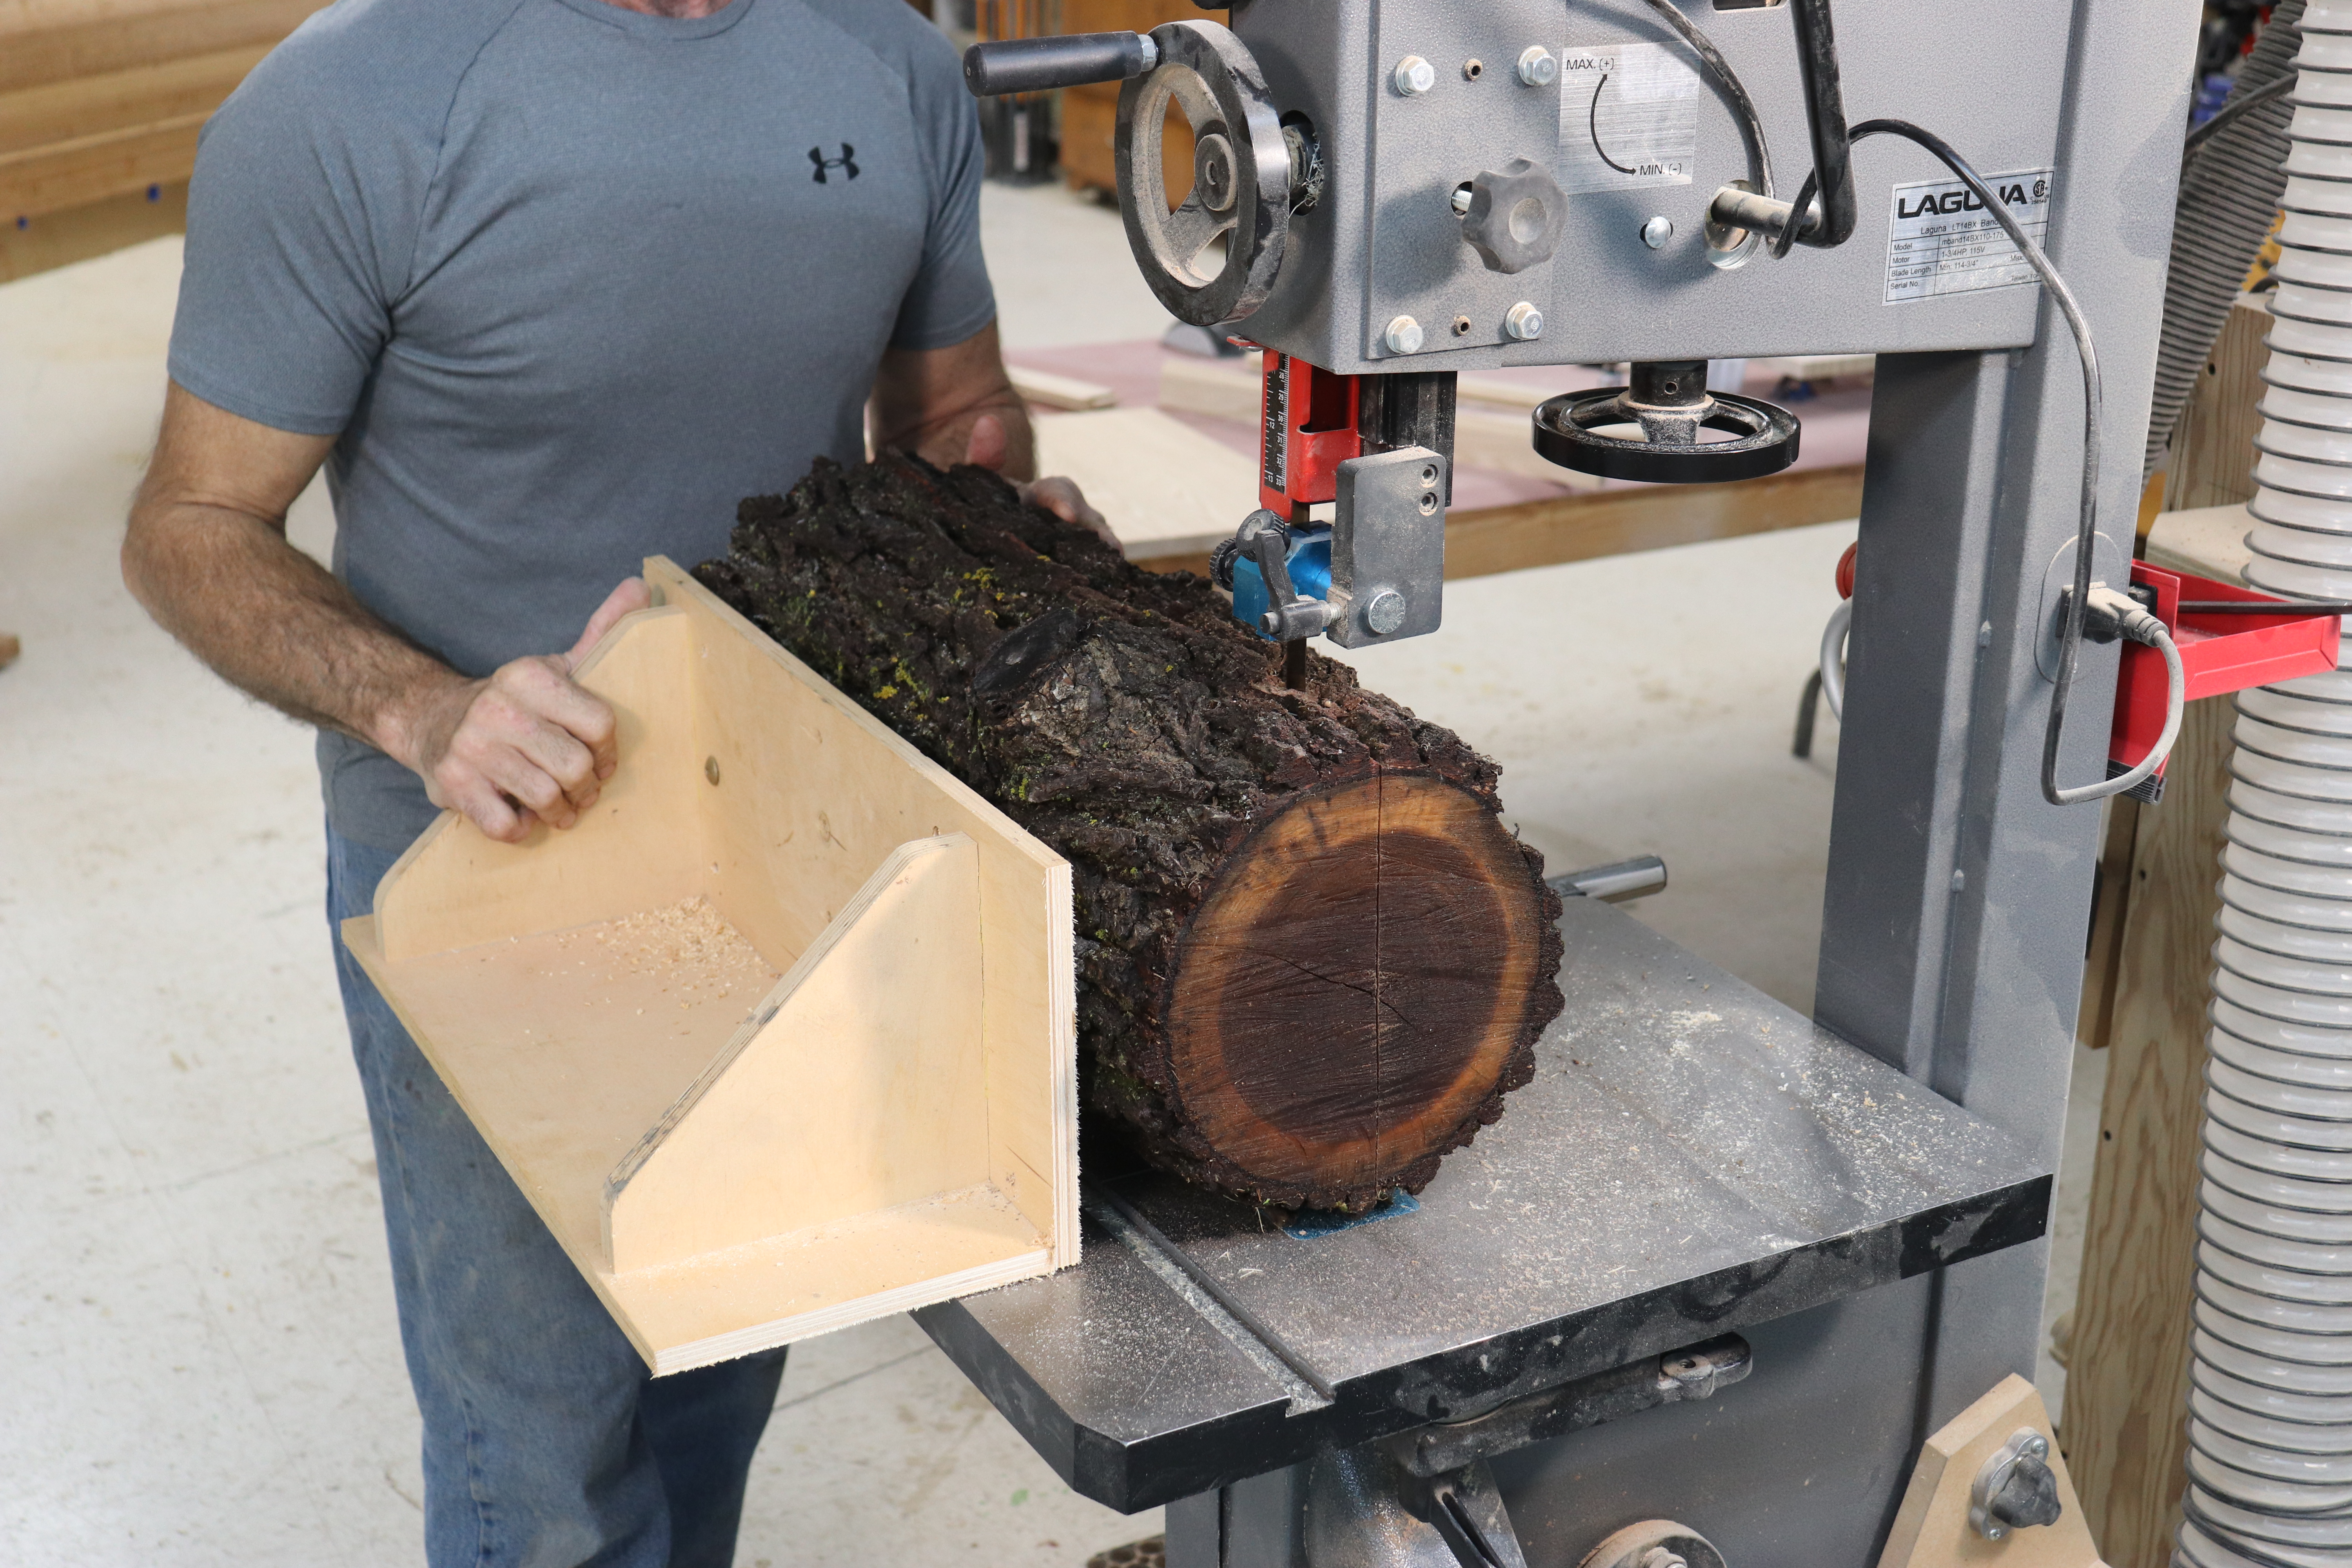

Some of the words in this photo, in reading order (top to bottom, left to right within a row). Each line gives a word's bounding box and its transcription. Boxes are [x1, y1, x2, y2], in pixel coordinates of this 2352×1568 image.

[1566, 58, 1596, 70] MAX.
[1599, 58, 1614, 71] (+)
[1640, 164, 1665, 176] MIN.
[1921, 225, 1947, 234] Laguna
[1952, 220, 1977, 231] LT14BX
[1894, 242, 1912, 251] Model
[1942, 231, 2004, 245] mband14BX110-175
[1970, 246, 1985, 255] 115V
[1911, 266, 1931, 275] Length
[1890, 281, 1907, 290] Serial
